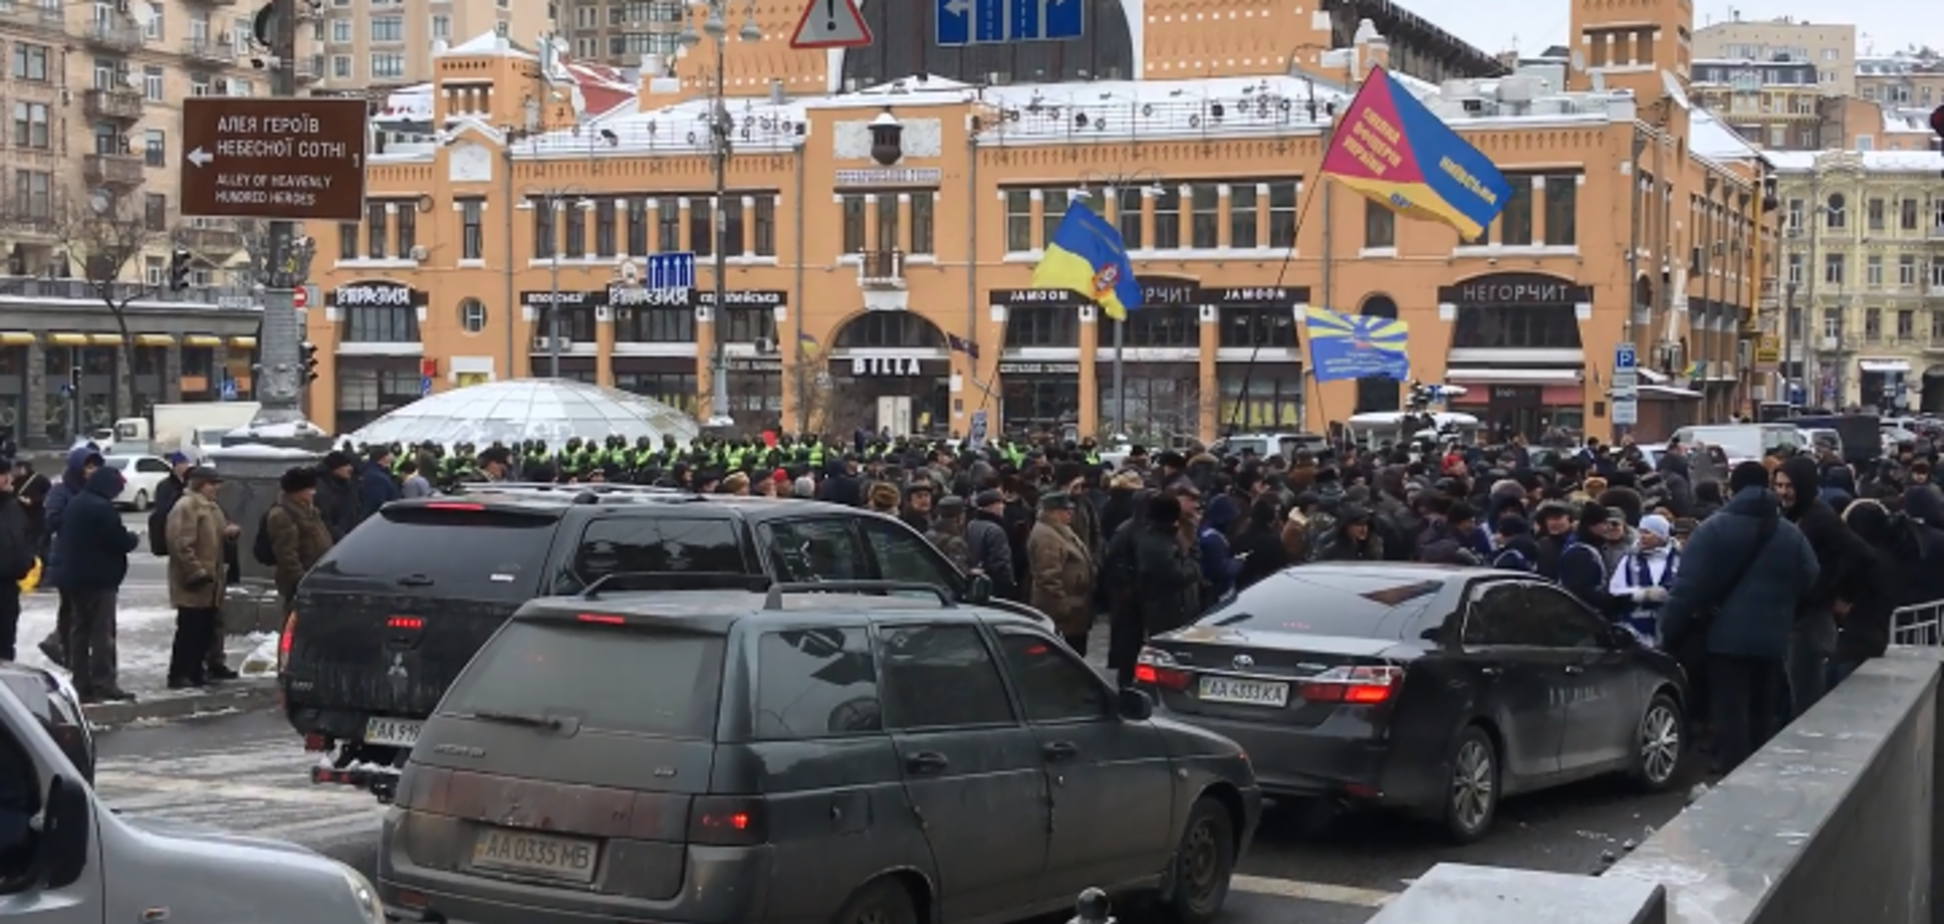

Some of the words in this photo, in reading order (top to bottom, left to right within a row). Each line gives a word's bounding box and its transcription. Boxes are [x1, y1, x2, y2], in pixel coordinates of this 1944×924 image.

[217, 115, 257, 133] АЛЕЯ
[263, 113, 320, 133] ГЕРОЇВ
[216, 137, 293, 157] НЕБЕСНОЇ
[298, 141, 346, 158] СОТНІ
[216, 173, 250, 187] ALLEY
[253, 174, 267, 187] OF
[271, 174, 332, 189] HEAVENLY
[215, 191, 268, 204] HUNDRED
[269, 192, 316, 206] HEROES
[1010, 290, 1069, 301] JAMOON
[1145, 287, 1193, 303] РЧИТ
[1223, 289, 1287, 301] JAMOON
[1463, 284, 1567, 301] НЕГОРЧИТ
[853, 358, 920, 375] BILLA
[1619, 351, 1632, 367] P
[485, 833, 511, 859] AA
[514, 837, 558, 866] 0335
[560, 843, 591, 870] MB
